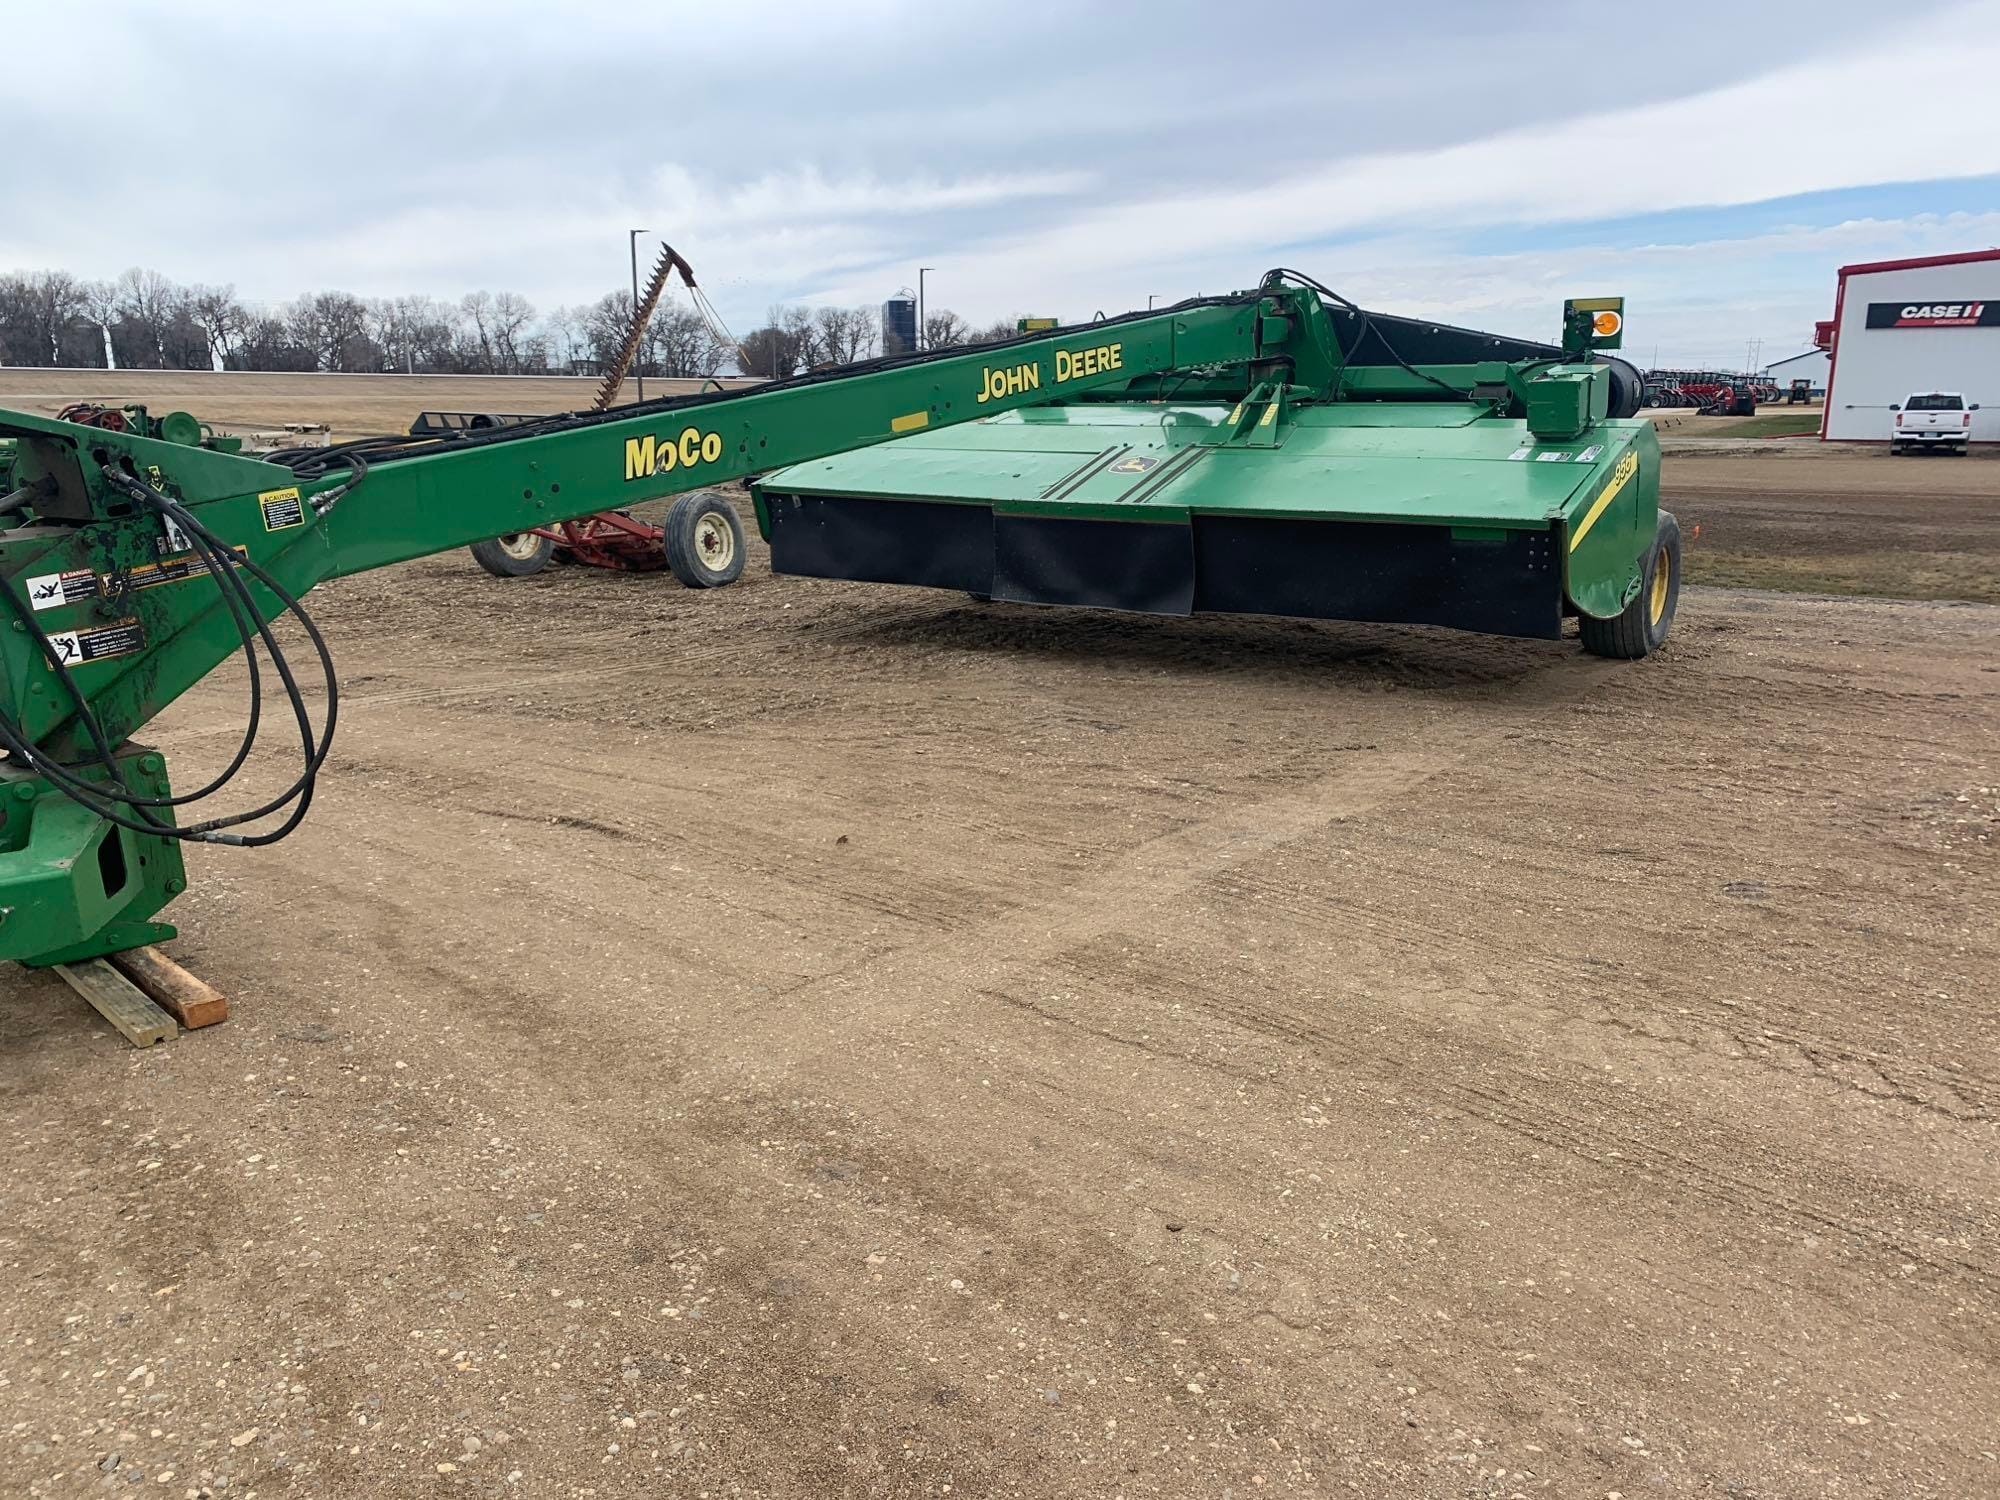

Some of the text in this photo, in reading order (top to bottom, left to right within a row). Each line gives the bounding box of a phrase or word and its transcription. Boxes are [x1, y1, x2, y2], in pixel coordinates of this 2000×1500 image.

[1901, 306, 1963, 319] CASE
[976, 343, 1123, 404] JOHN DEERE
[625, 426, 723, 481] MoCo
[1615, 451, 1631, 486] 956
[268, 492, 296, 503] CAUTION
